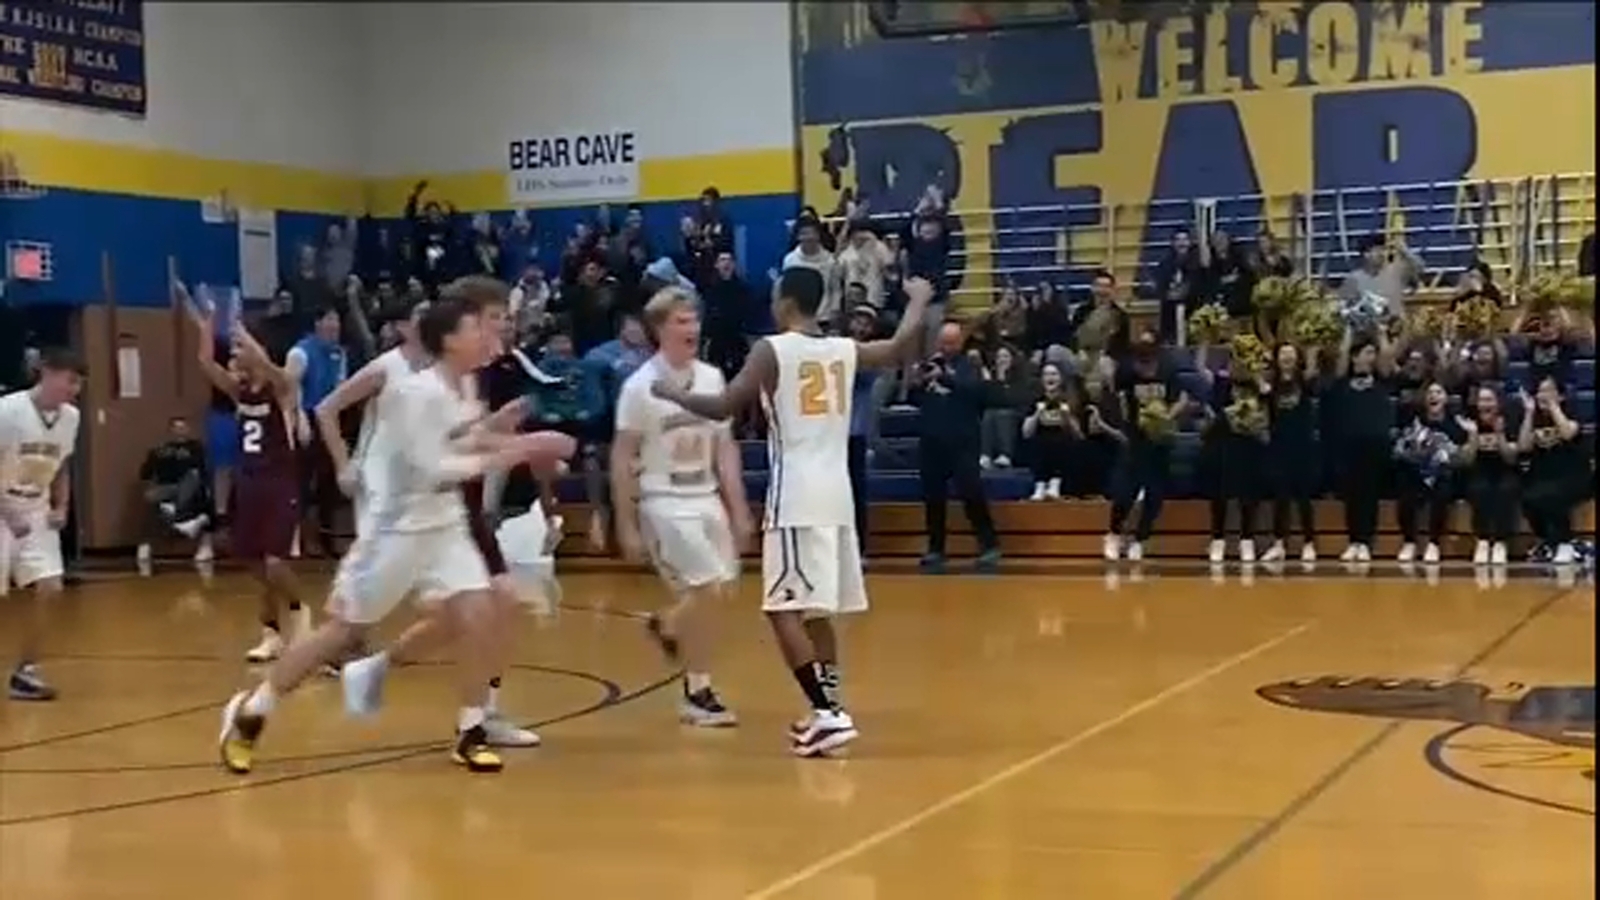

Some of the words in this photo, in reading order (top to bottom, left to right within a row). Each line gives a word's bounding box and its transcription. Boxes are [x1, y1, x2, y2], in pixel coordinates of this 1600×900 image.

[1090, 2, 1484, 102] WELCOME
[509, 137, 571, 170] BEAR
[575, 133, 634, 167] CAVE
[850, 86, 1478, 308] BEAR
[799, 362, 847, 416] 21
[243, 420, 262, 453] 2
